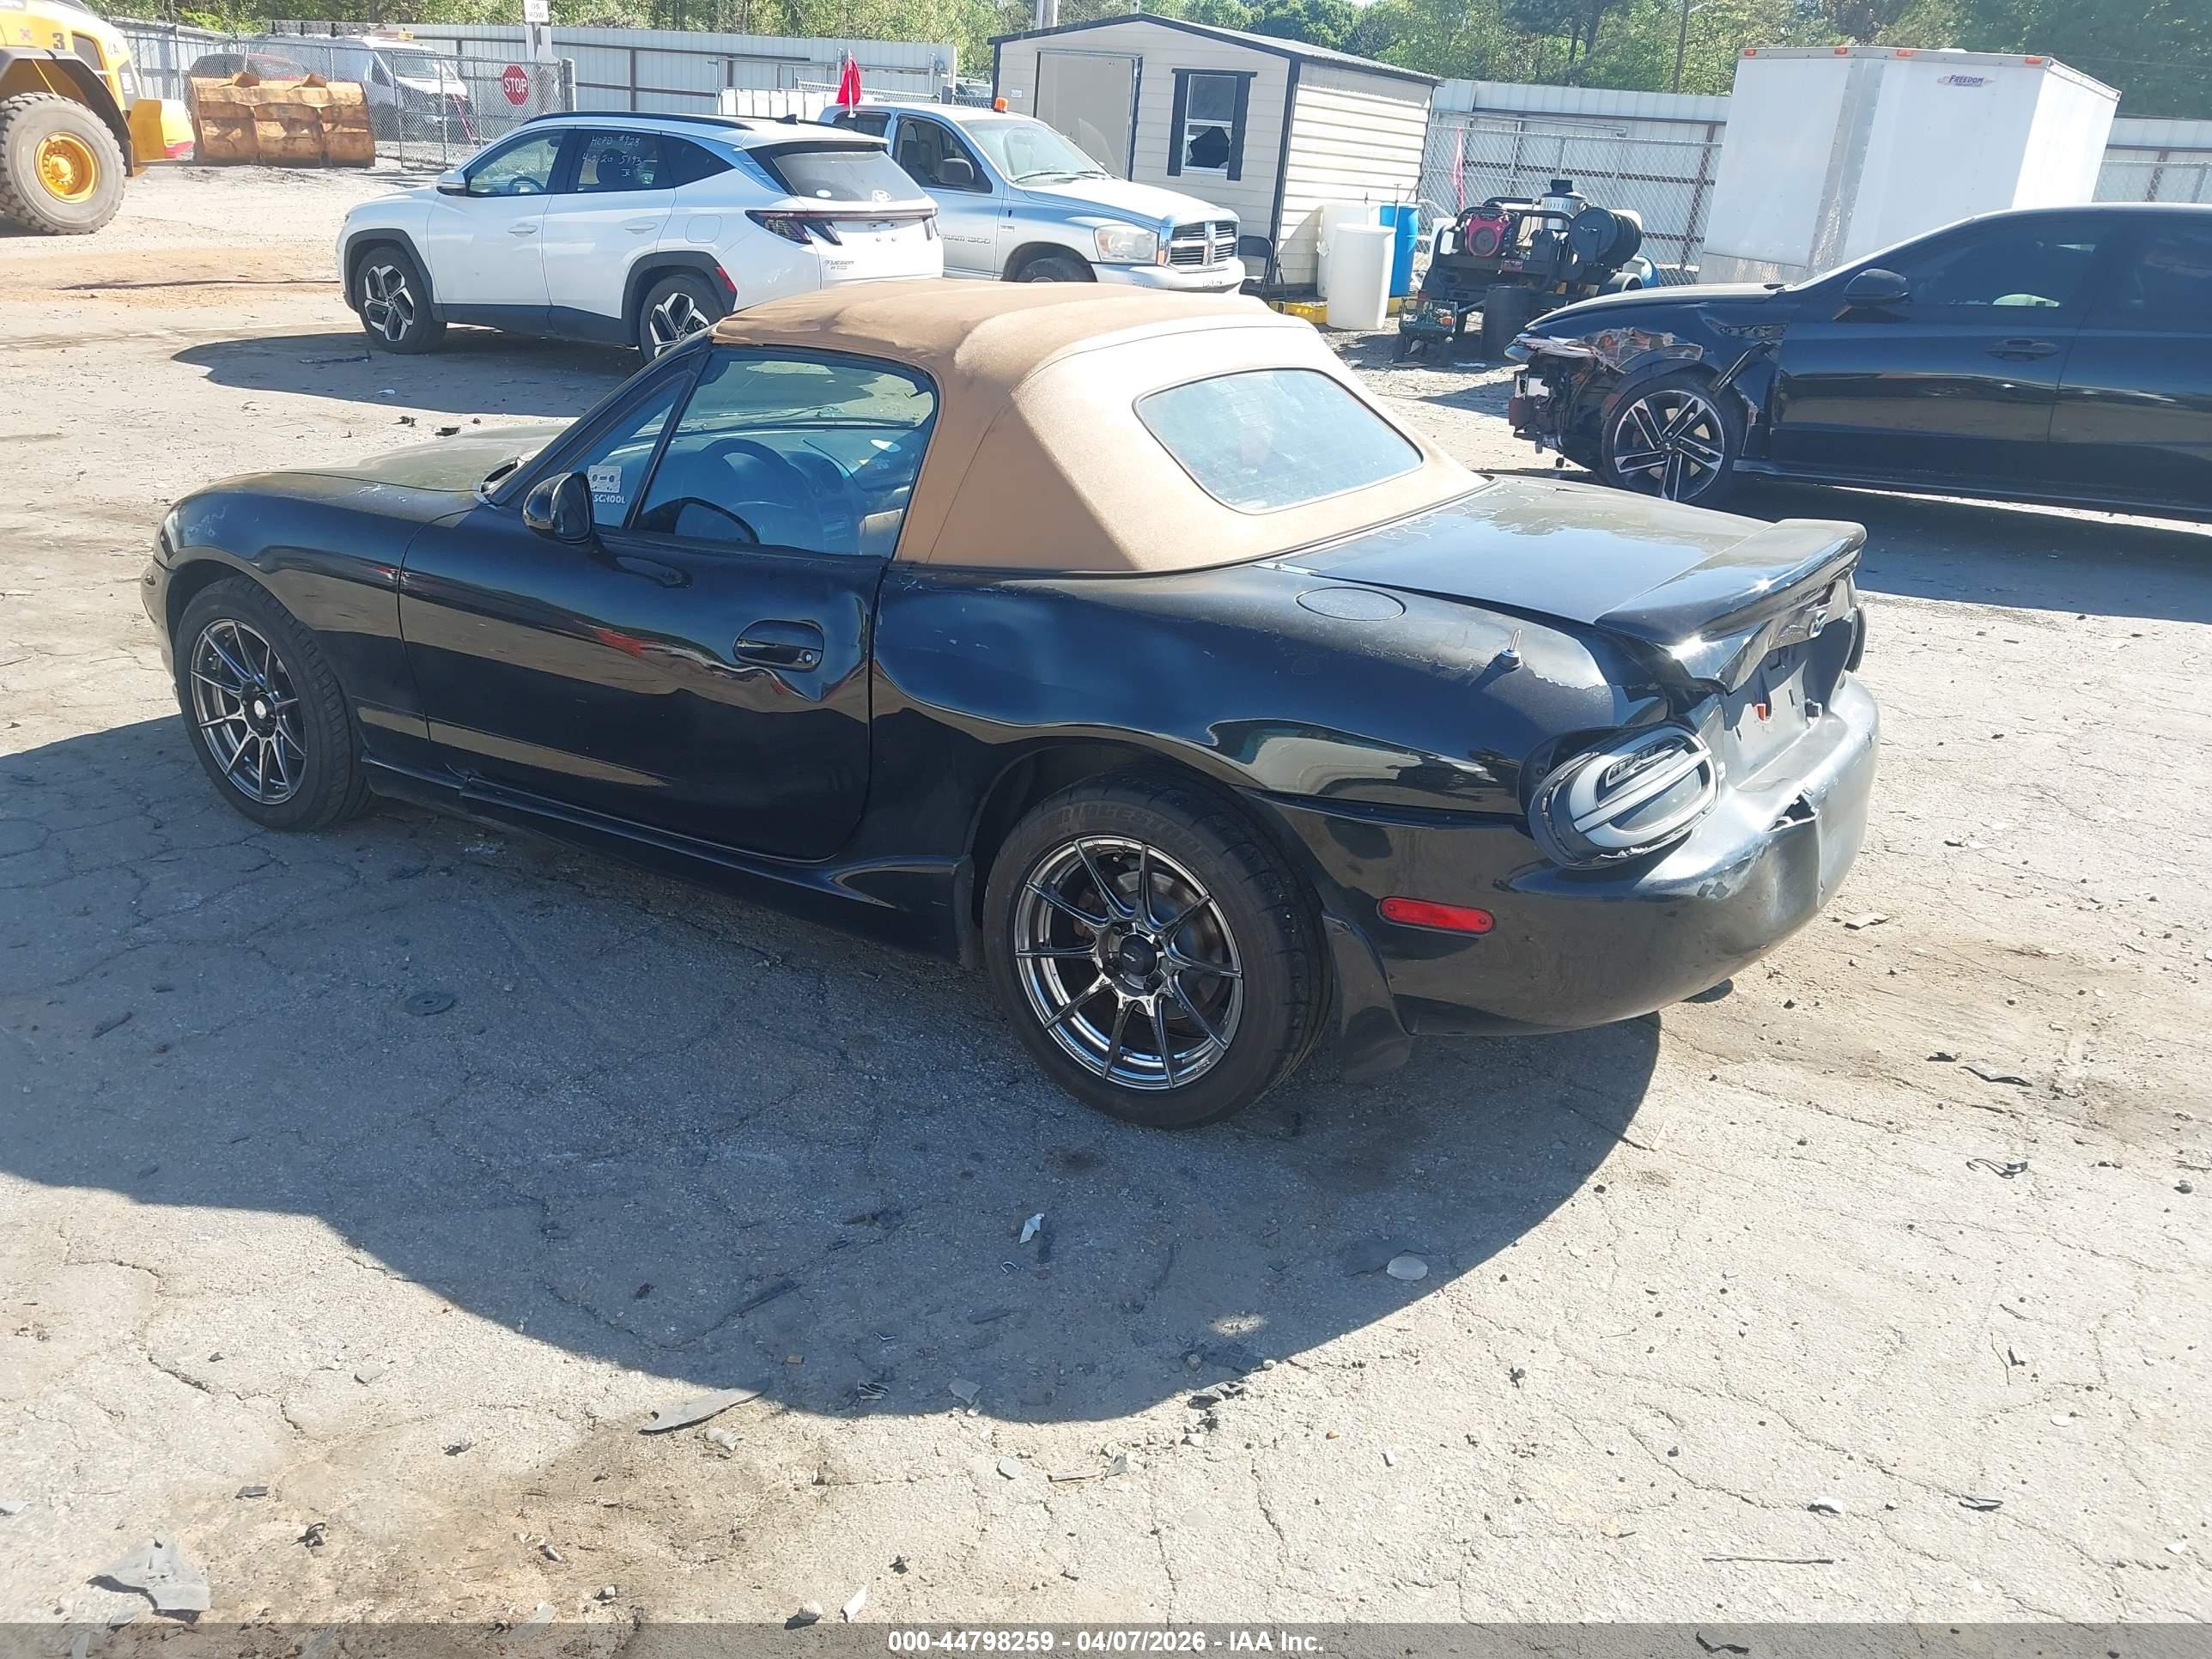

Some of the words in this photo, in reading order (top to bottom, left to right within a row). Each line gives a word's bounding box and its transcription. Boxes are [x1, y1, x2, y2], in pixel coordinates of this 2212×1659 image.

[52, 33, 65, 49] 3
[504, 77, 527, 94] STOP
[1948, 75, 1984, 83] FREEDOM
